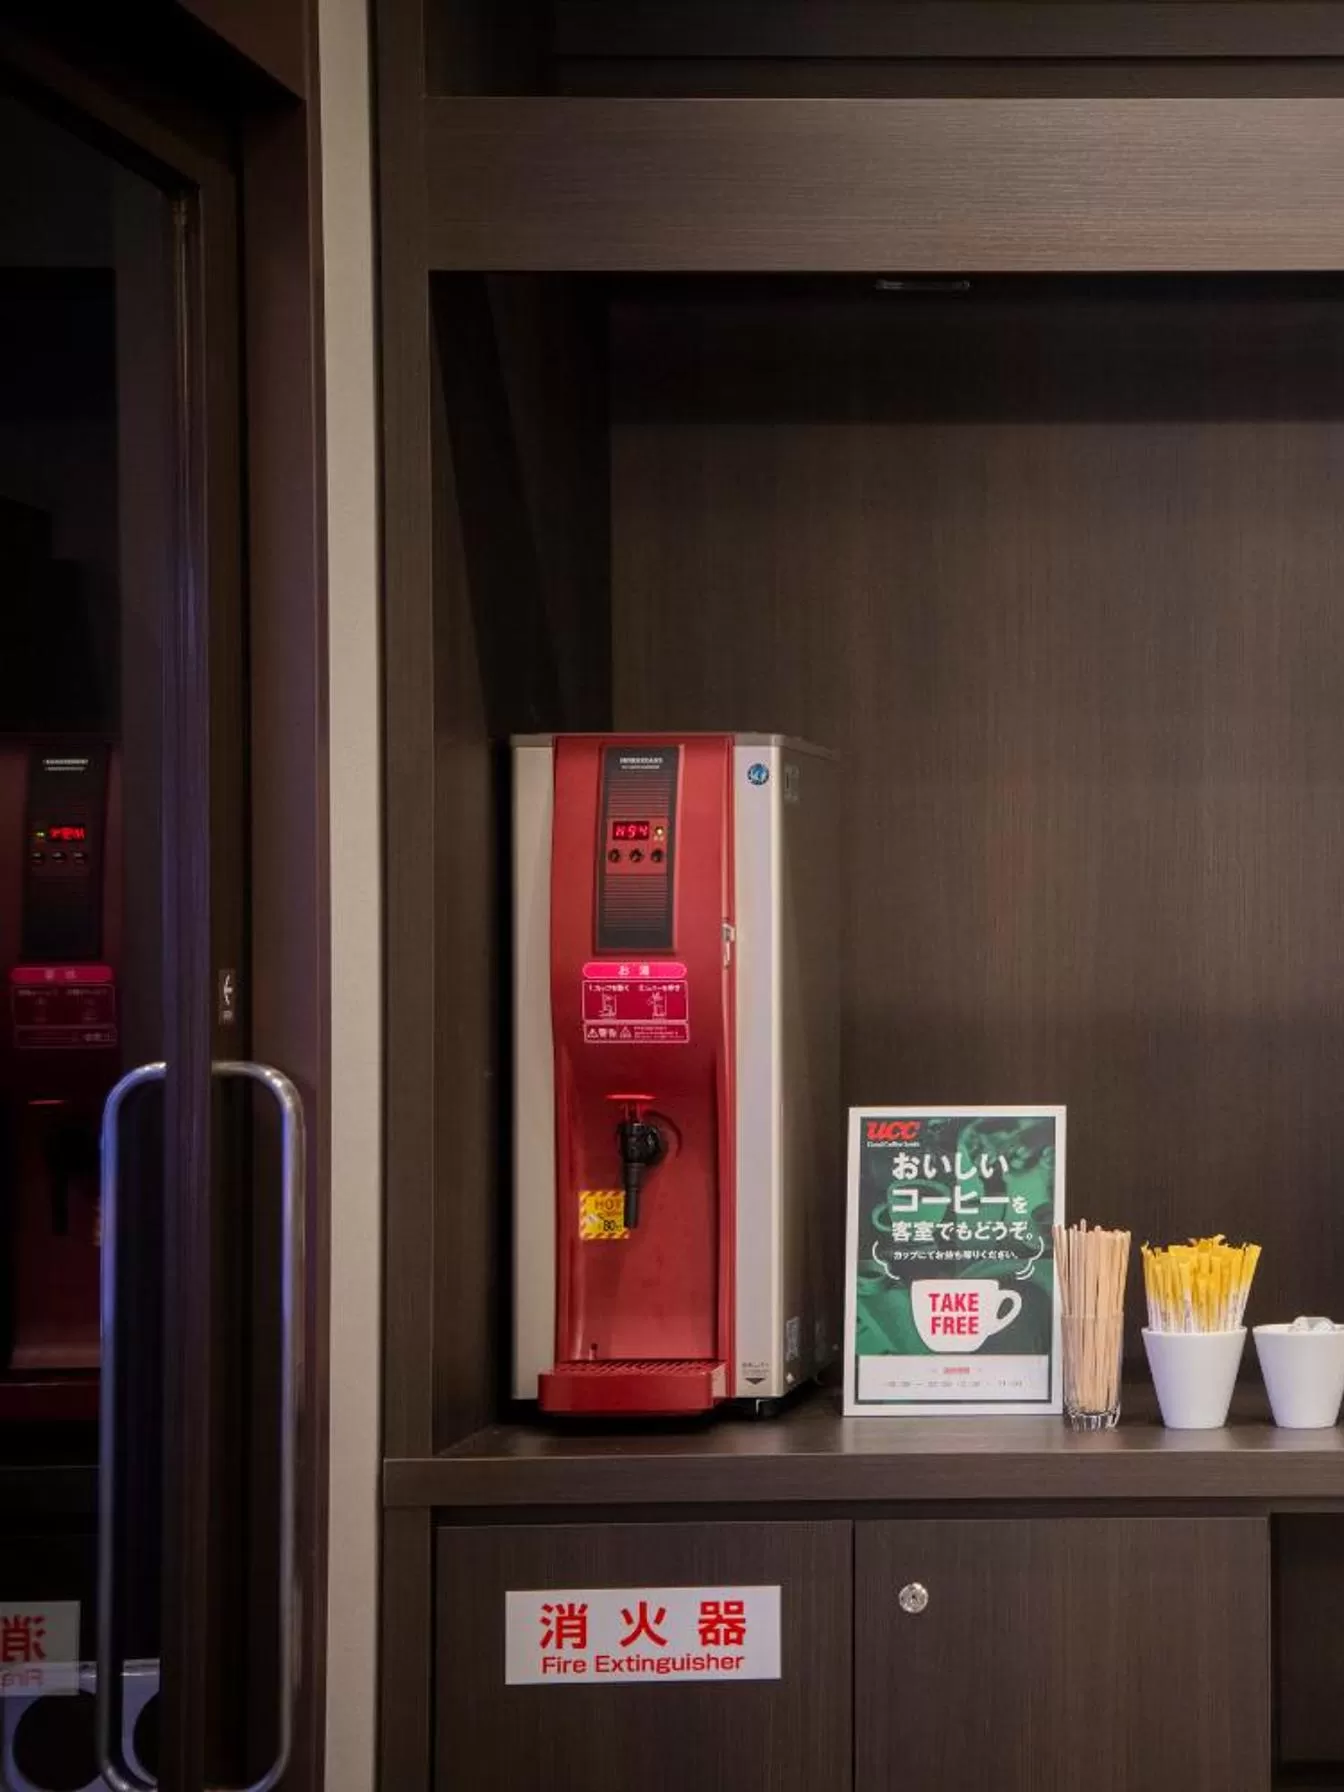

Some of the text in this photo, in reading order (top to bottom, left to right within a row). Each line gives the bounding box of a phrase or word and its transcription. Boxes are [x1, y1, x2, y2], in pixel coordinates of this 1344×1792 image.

[866, 1120, 921, 1140] UCC
[892, 1152, 1009, 1180] おいしい
[892, 1185, 1028, 1214] コーヒーを
[891, 1220, 1033, 1242] 客室でもどうぞ。
[928, 1293, 979, 1312] TAKE
[930, 1316, 979, 1335] FREE
[539, 1600, 747, 1650] 消火器
[542, 1653, 745, 1675] Fire Extinguisher
